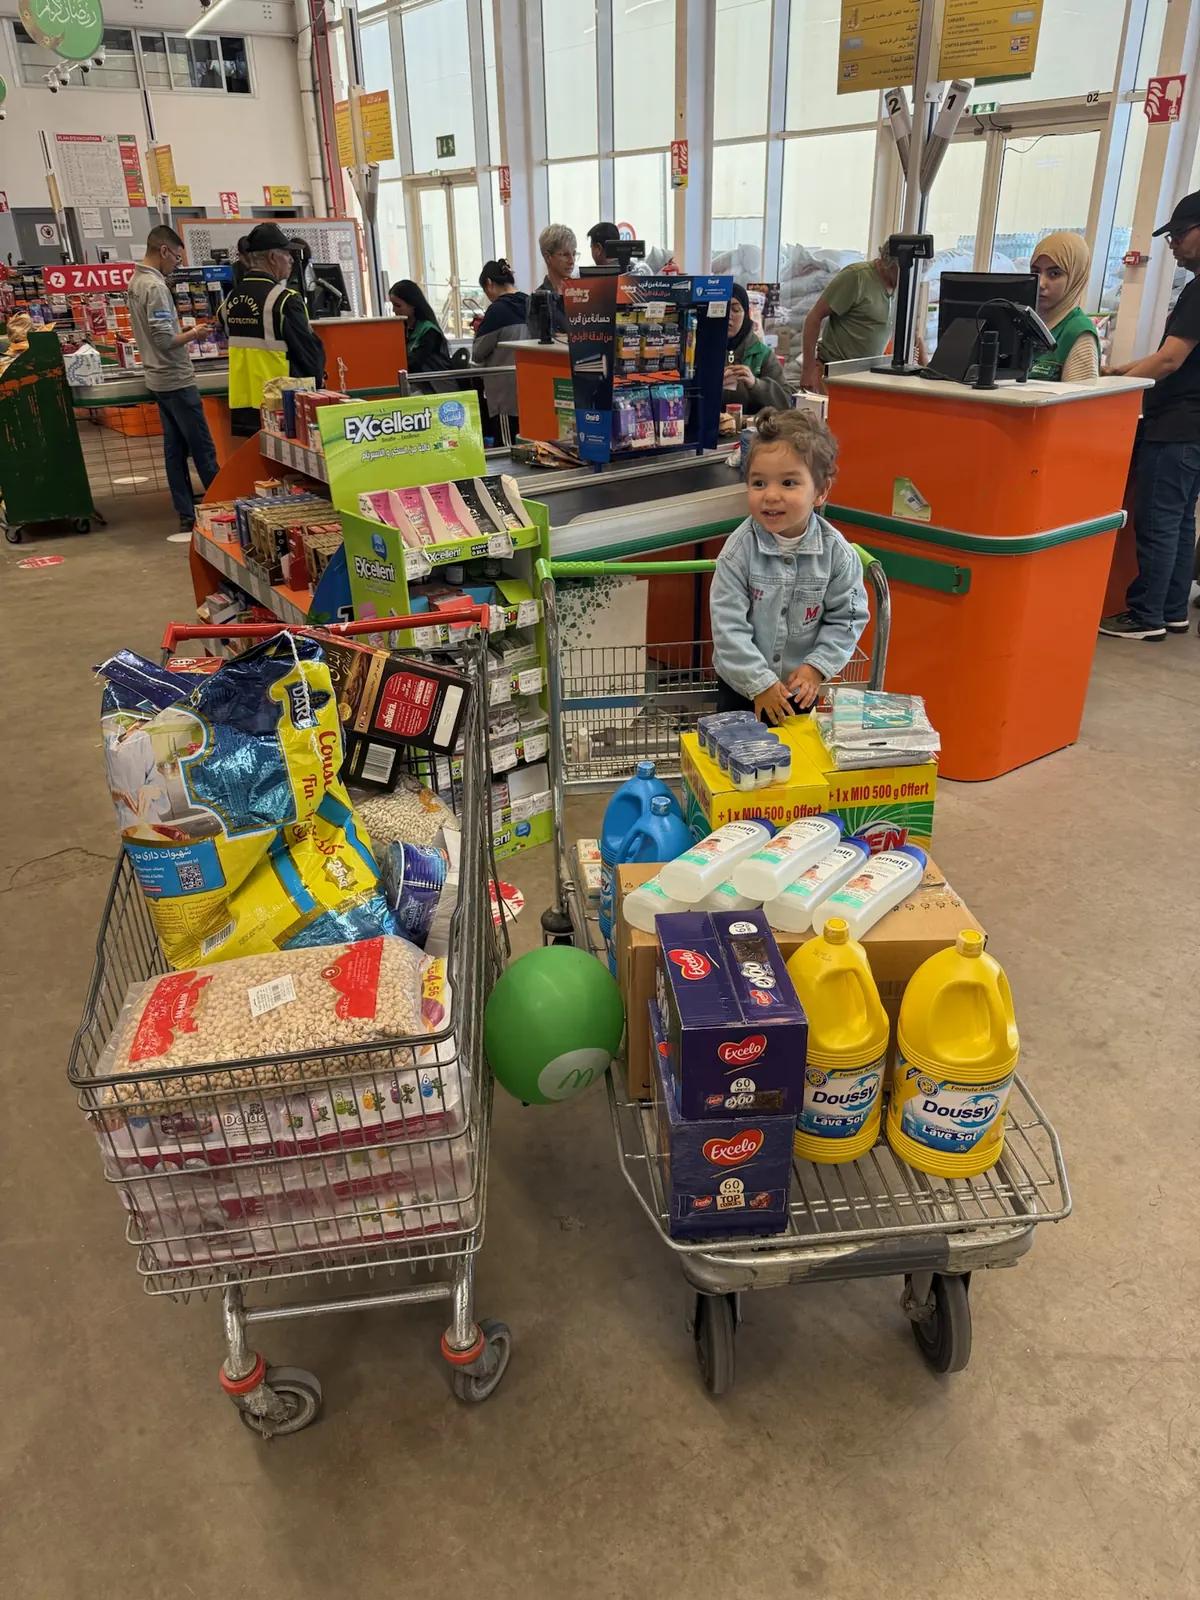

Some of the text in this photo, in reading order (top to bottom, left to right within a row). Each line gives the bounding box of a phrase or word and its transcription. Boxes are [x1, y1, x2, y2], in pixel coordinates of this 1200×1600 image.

[889, 98, 901, 115] 2
[948, 95, 957, 110] 1
[1086, 93, 1099, 103] 02
[344, 407, 431, 444] EXcellent
[354, 556, 396, 583] EXcellent
[302, 774, 317, 799] Fin
[837, 788, 842, 802] 1
[843, 791, 849, 802] x
[851, 786, 869, 801] MIO
[872, 784, 892, 799] 500
[894, 788, 899, 800] g
[901, 782, 929, 797] Offert
[718, 804, 822, 822] + 1 x MIO 500 g Offert
[795, 820, 827, 832] amalfi
[866, 828, 909, 850] EN
[875, 856, 909, 868] amalfi
[680, 951, 706, 975] Excelo
[724, 1042, 761, 1060] Excelo
[423, 1074, 430, 1085] 6
[736, 1079, 751, 1088] 60
[812, 1083, 877, 1105] Doussy
[922, 1100, 994, 1120] Doussy
[813, 1113, 864, 1127] Lave Sol
[922, 1124, 977, 1142] Lave Sol
[711, 1138, 757, 1160] Excelo
[724, 1179, 740, 1190] 60
[720, 1194, 741, 1203] TOP
